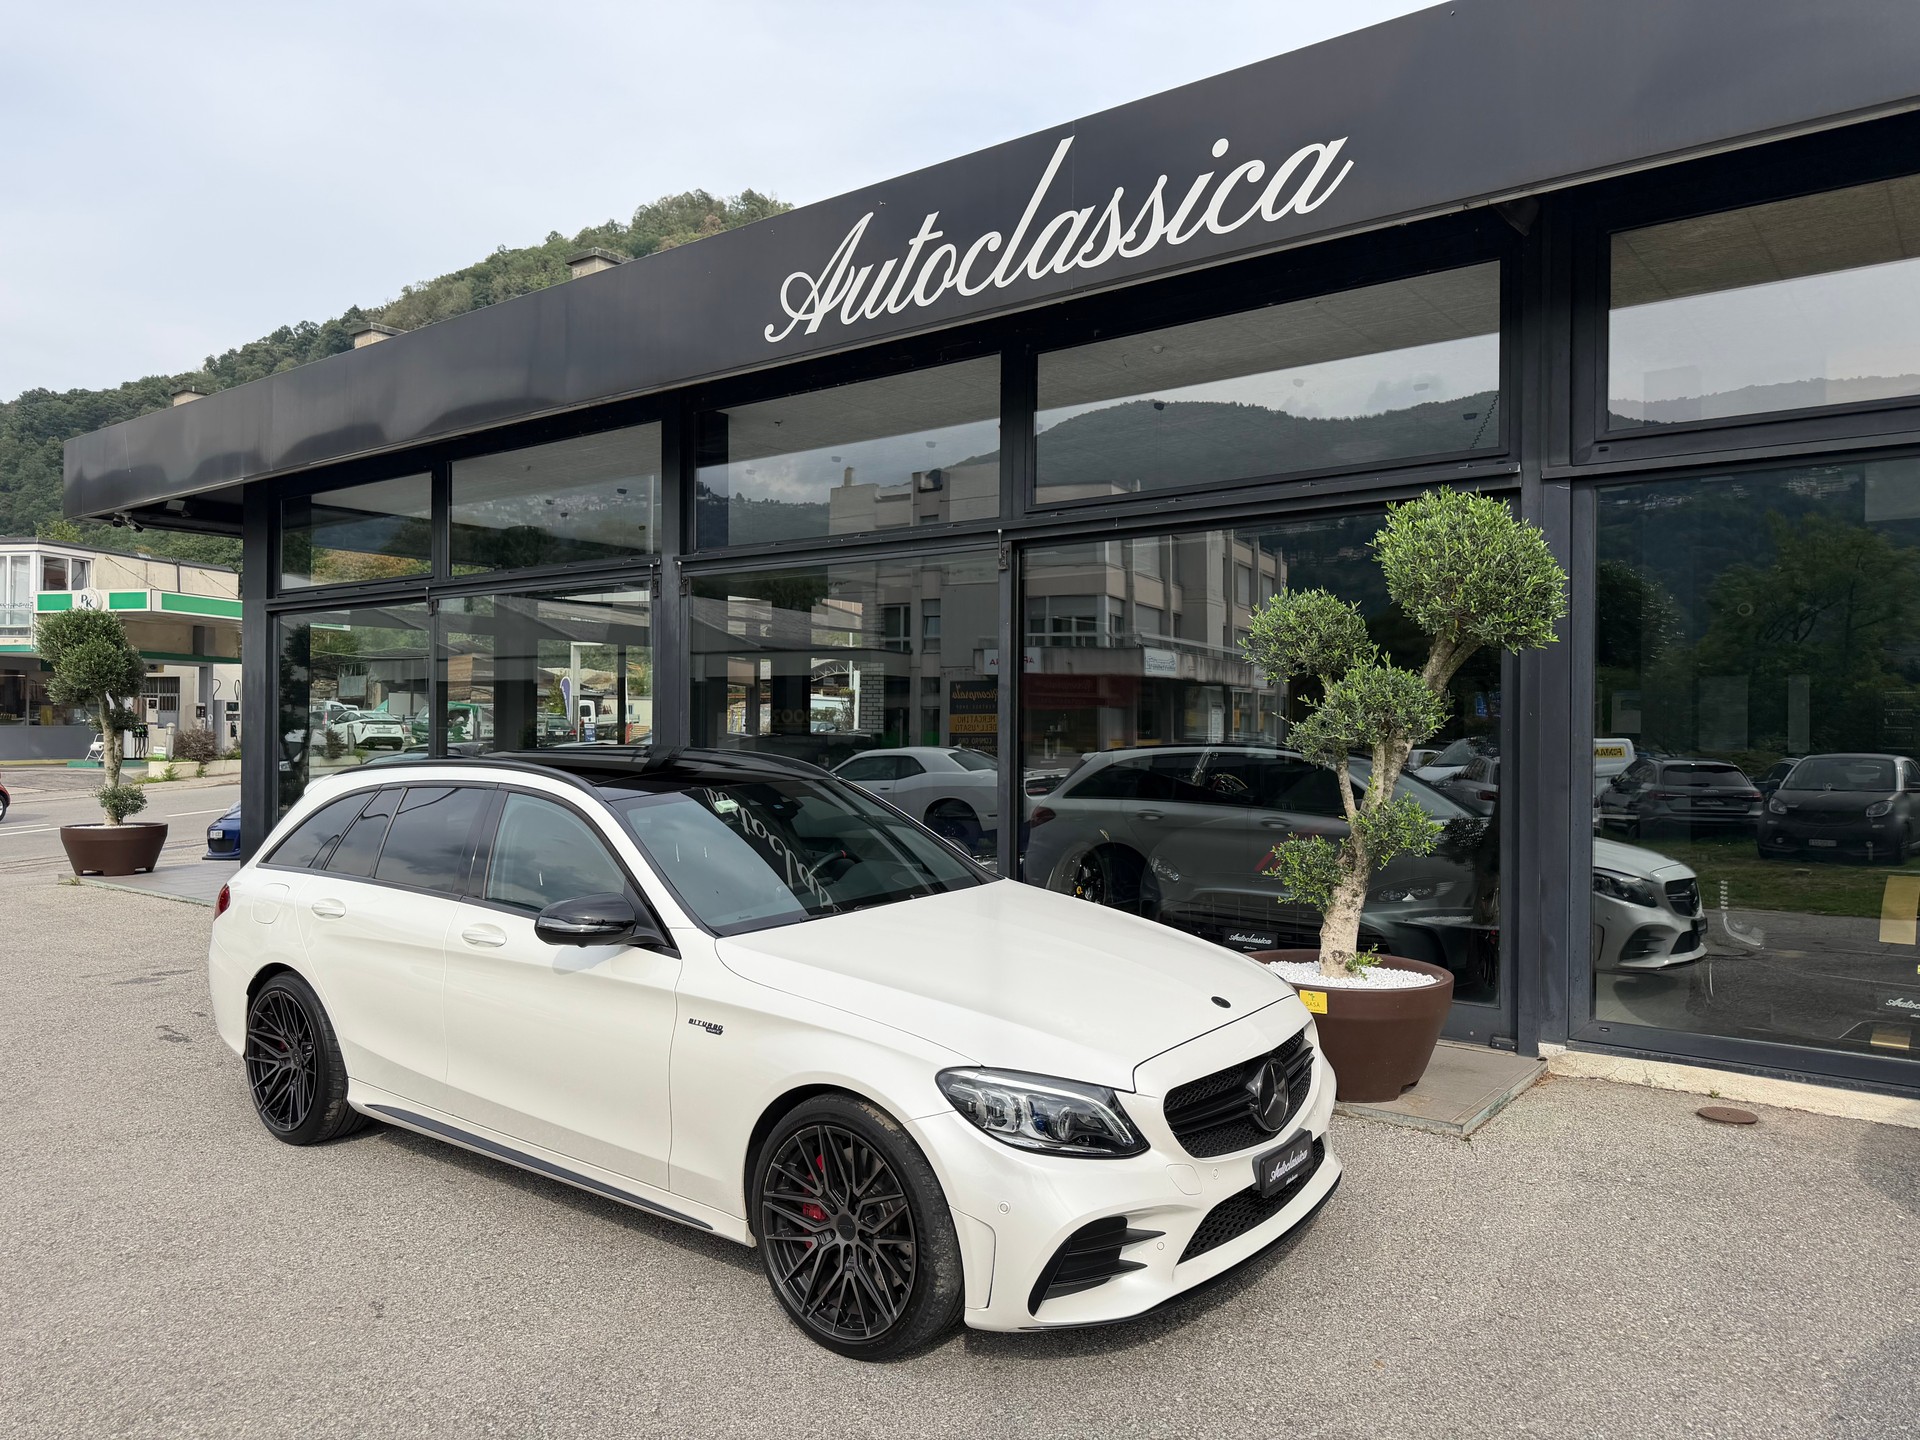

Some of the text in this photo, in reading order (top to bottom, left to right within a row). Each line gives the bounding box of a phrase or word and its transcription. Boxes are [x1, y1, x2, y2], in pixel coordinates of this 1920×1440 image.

[764, 136, 1354, 343] Autoclassica
[1229, 933, 1272, 945] Autoclassica
[688, 1018, 723, 1030] BITURBO
[1270, 1149, 1307, 1182] Autoclassica
